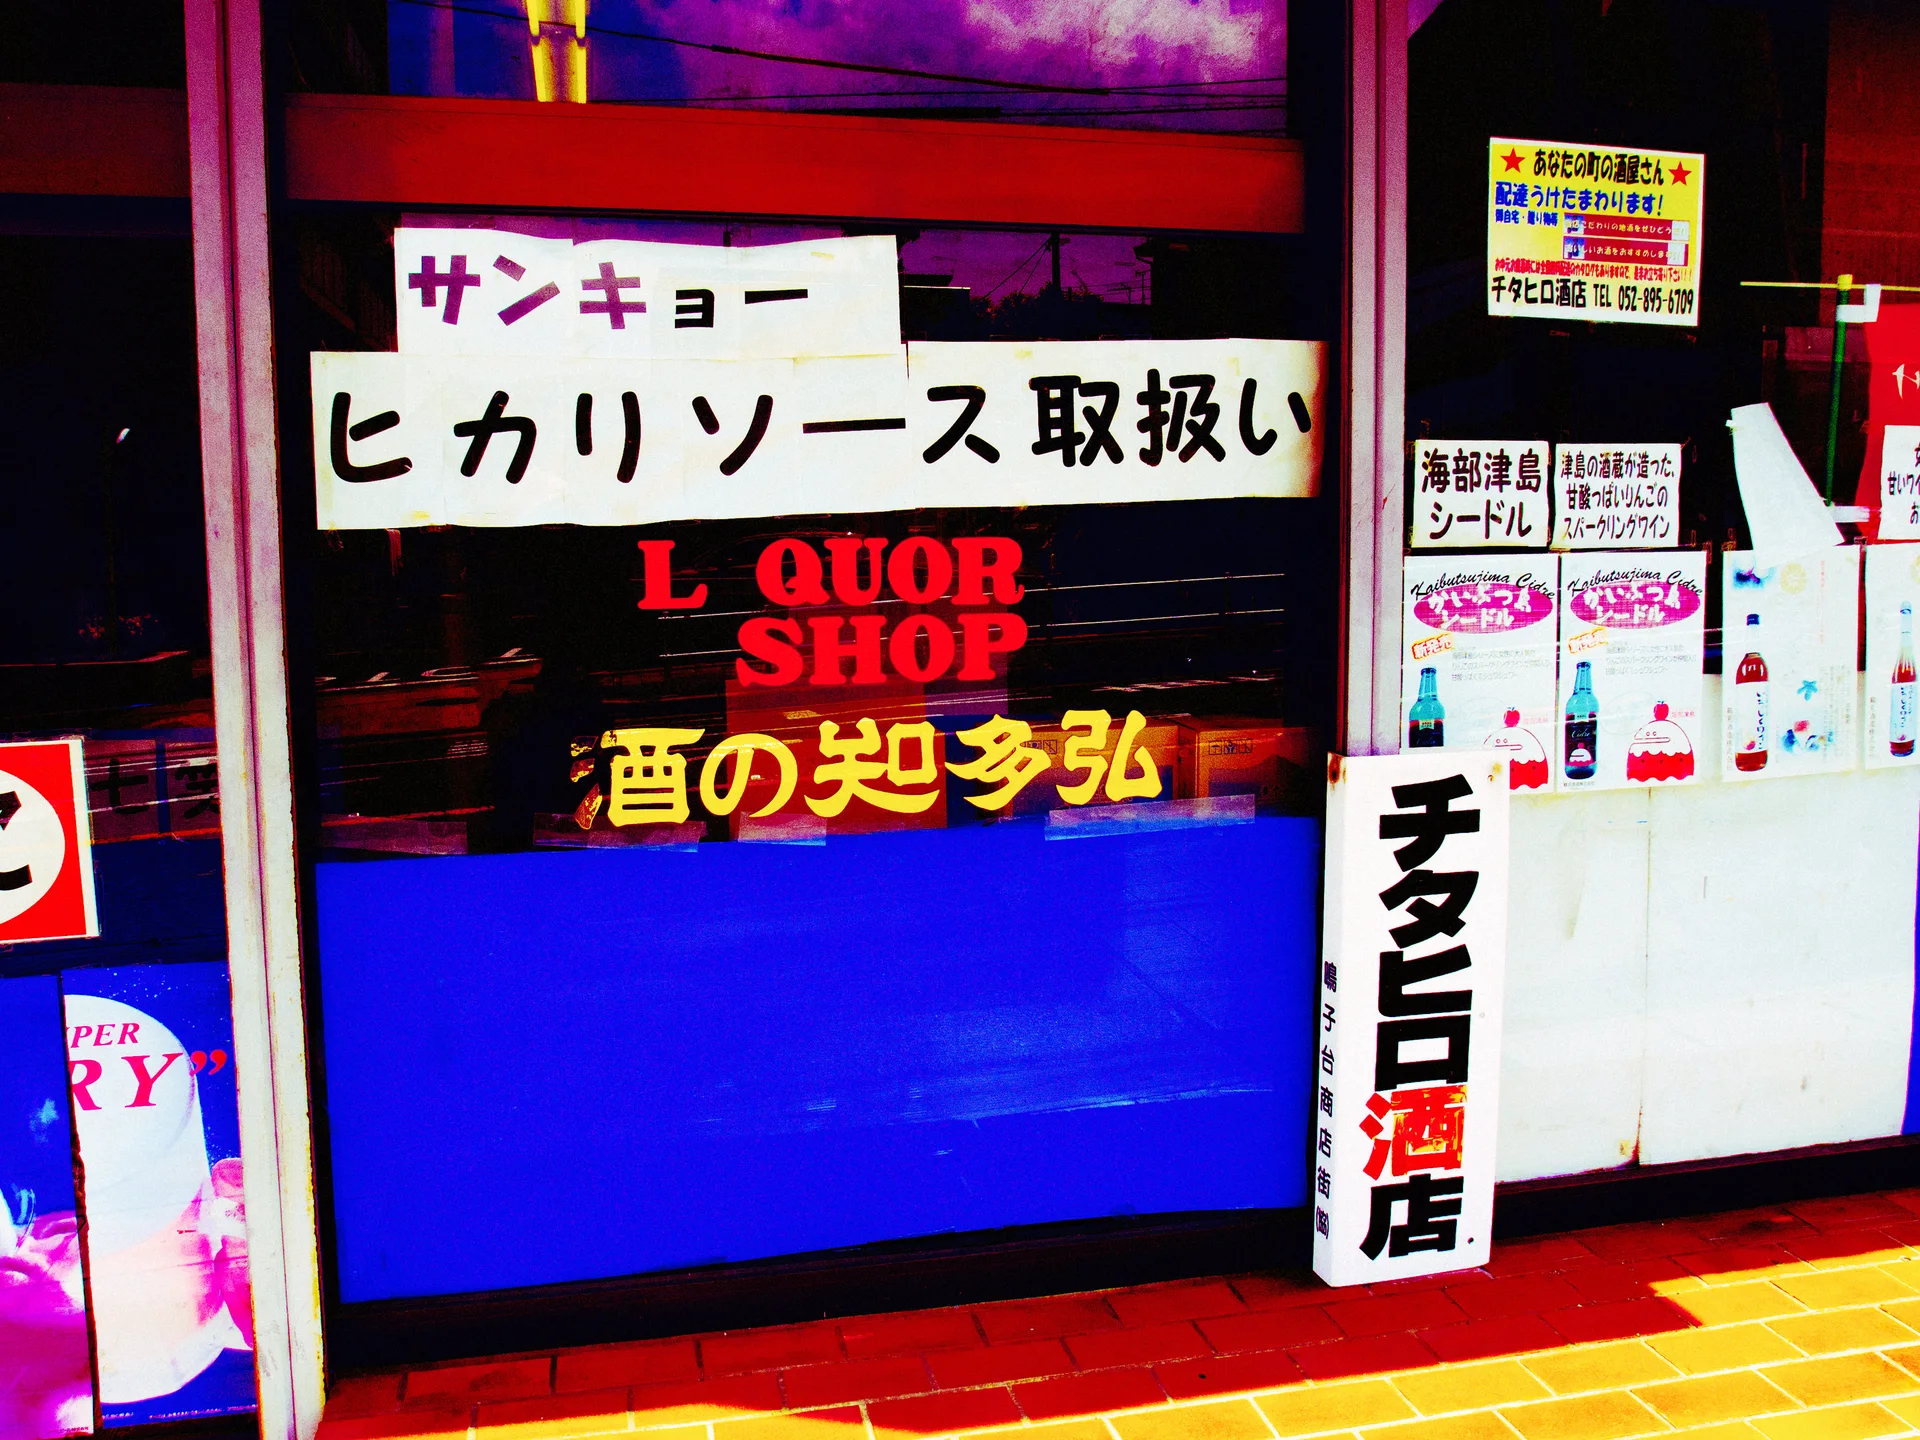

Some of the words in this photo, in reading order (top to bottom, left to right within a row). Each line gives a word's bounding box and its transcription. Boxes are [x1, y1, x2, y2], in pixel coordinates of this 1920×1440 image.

[1534, 149, 1664, 186] あなたの町の酒屋さん
[408, 254, 810, 328] サンキョー
[1491, 276, 1587, 308] チタヒロ酒店
[1593, 284, 1612, 307] TEL
[1618, 285, 1694, 314] 052-895-6709
[330, 367, 1312, 484] ヒカリソース取扱い
[1421, 448, 1541, 493] 海部津島
[1560, 451, 1675, 480] 津島の酒蔵が造った、
[1566, 483, 1668, 510] 甘酸っぱいりんごの
[1429, 499, 1532, 540] シードル
[1563, 514, 1670, 540] スパークリングワイン
[1410, 569, 1511, 601] Kaibutsujima
[1515, 572, 1556, 600] Cidre
[1567, 567, 1662, 597] Kaibutsujima
[1666, 569, 1703, 596] Cidre
[1440, 607, 1515, 630] シードル
[1595, 603, 1666, 625] シードル
[735, 611, 1028, 687] SHOP
[570, 709, 1163, 831] 酒の知多弘
[1358, 773, 1481, 1261] チタヒロ酒店
